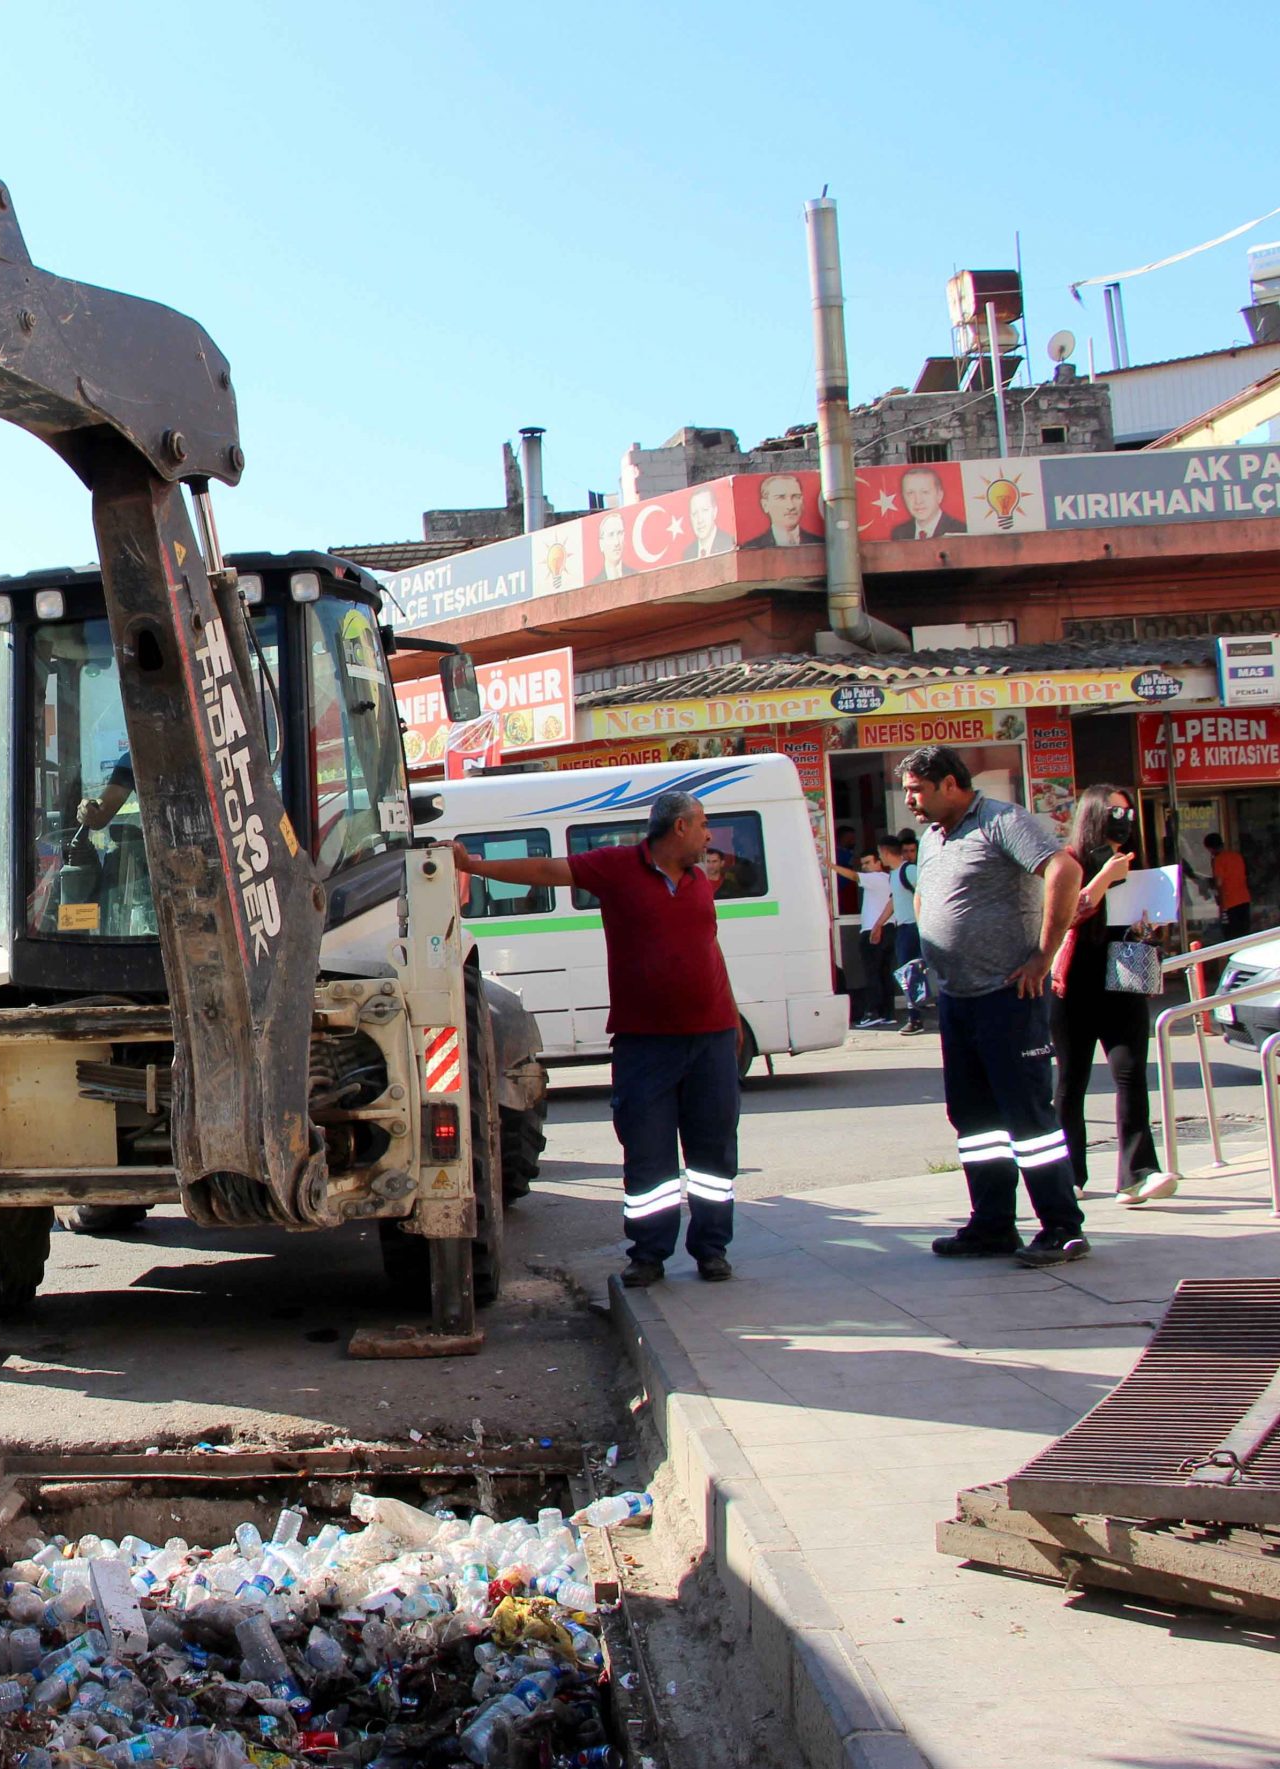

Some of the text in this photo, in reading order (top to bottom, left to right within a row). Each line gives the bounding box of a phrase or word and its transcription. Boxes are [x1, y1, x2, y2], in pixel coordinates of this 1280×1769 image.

[1183, 454, 1232, 484] AK
[1054, 486, 1216, 521] KIRIKHAN
[401, 563, 453, 598] PARTİ
[433, 569, 527, 616] TEŞKİLATI
[1237, 667, 1265, 678] MAS
[840, 687, 875, 700] Alo Paket
[904, 678, 1121, 711] Nefis Döner
[1137, 683, 1180, 696] 345 32 33
[605, 697, 821, 736] Nefis Döner
[837, 697, 881, 710] 345 32 33
[864, 716, 985, 746] NEFİS DÖNER
[1033, 727, 1067, 738] Nefis
[1155, 717, 1267, 744] ALPEREN
[608, 747, 662, 767] DÖNER
[784, 742, 819, 753] Nefis
[1190, 747, 1201, 768] &
[1205, 743, 1280, 767] KIRTASİYE
[204, 618, 282, 938] HATSU
